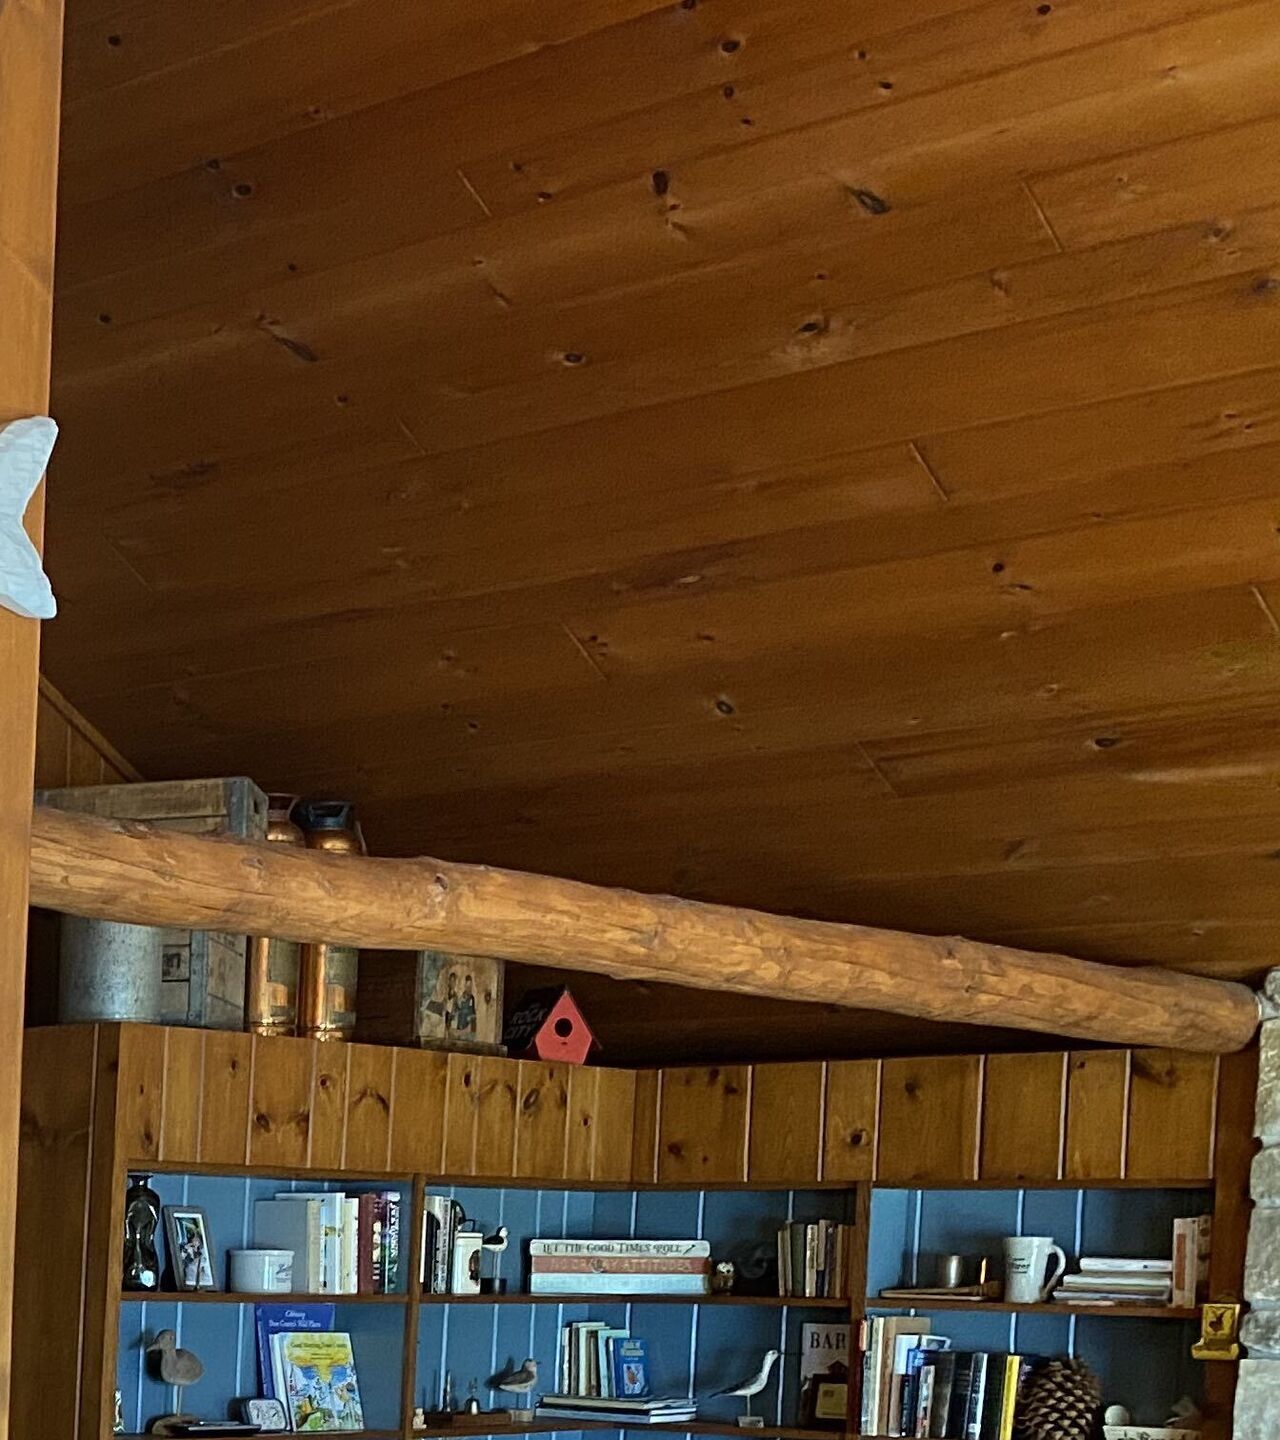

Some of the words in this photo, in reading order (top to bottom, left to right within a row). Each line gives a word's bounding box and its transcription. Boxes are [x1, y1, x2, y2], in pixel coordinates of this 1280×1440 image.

[542, 1243, 560, 1256] LET
[586, 1242, 615, 1254] GOOD
[617, 1242, 652, 1254] TIMES
[652, 1243, 682, 1256] ROLL
